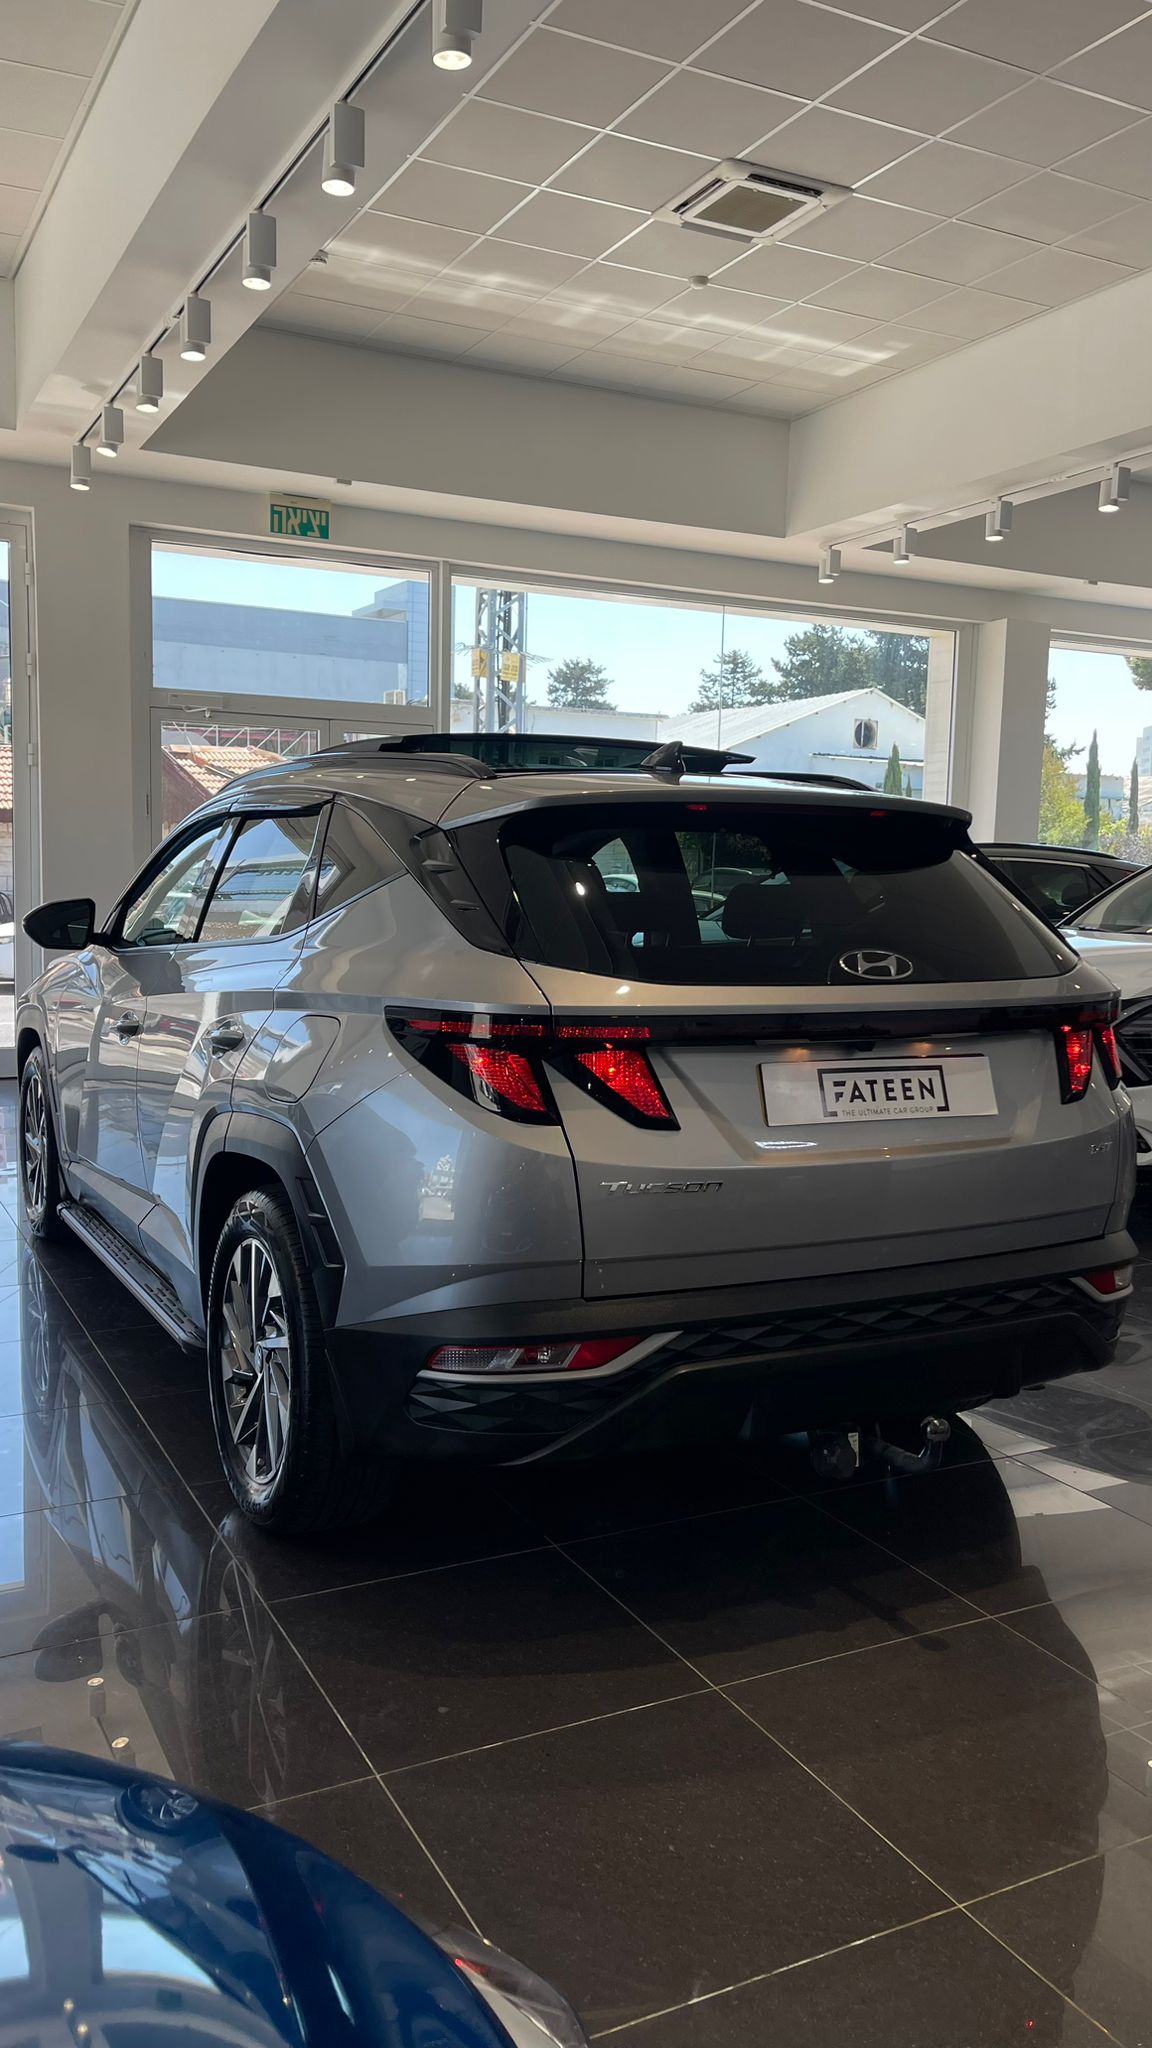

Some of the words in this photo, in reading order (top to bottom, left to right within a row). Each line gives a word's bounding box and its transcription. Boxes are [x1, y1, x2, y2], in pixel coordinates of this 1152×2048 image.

[273, 506, 327, 537] יציאה
[833, 1078, 936, 1103] FATEEN
[842, 1108, 855, 1117] THE
[858, 1106, 892, 1116] ULTIMATE
[893, 1105, 908, 1115] CAR
[910, 1105, 934, 1114] GROUP
